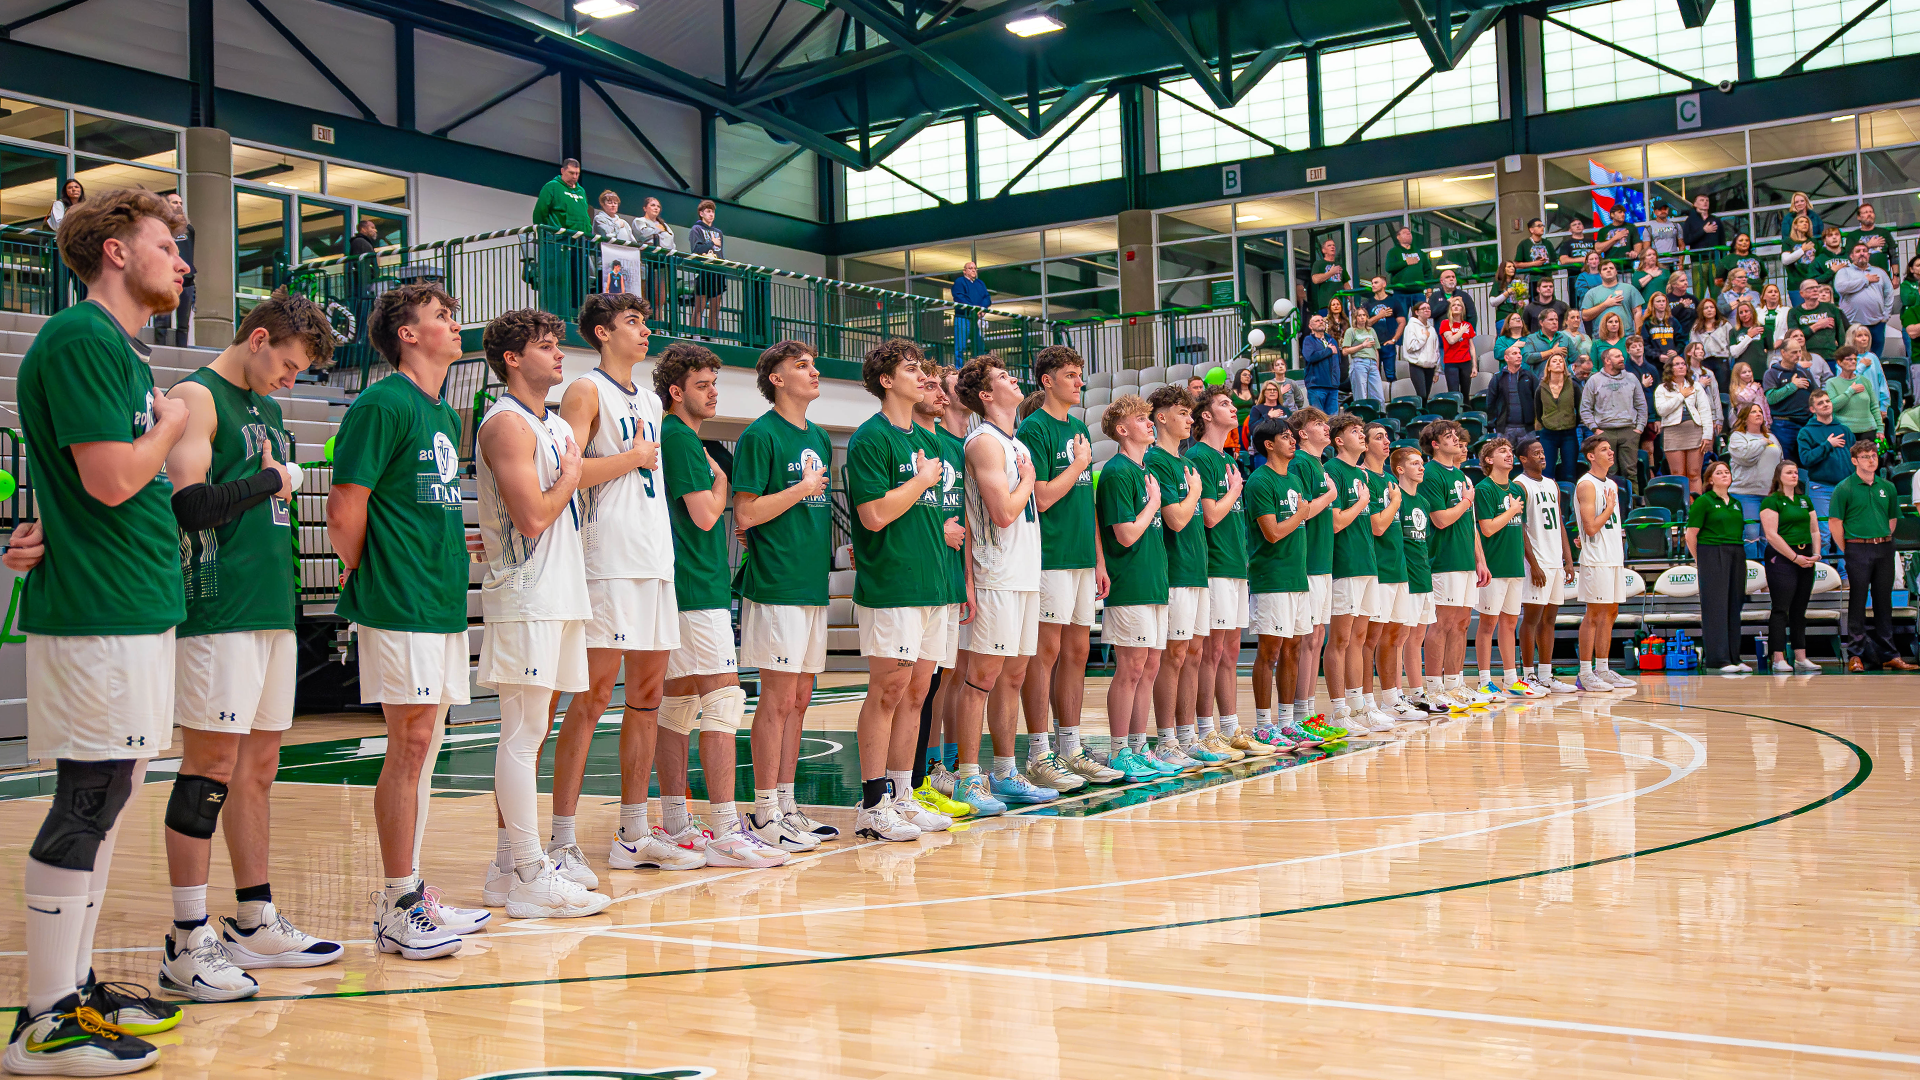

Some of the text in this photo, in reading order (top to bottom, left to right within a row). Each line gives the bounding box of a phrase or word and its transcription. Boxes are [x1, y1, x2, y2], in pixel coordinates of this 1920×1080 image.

[1680, 100, 1696, 122] C
[1225, 170, 1238, 189] B
[1310, 168, 1323, 180] EXIT
[134, 411, 147, 426] 20
[419, 449, 434, 461] 20
[787, 462, 801, 472] 20
[899, 463, 912, 473] 20
[1542, 507, 1558, 530] 31
[1668, 574, 1696, 582] TITANS
